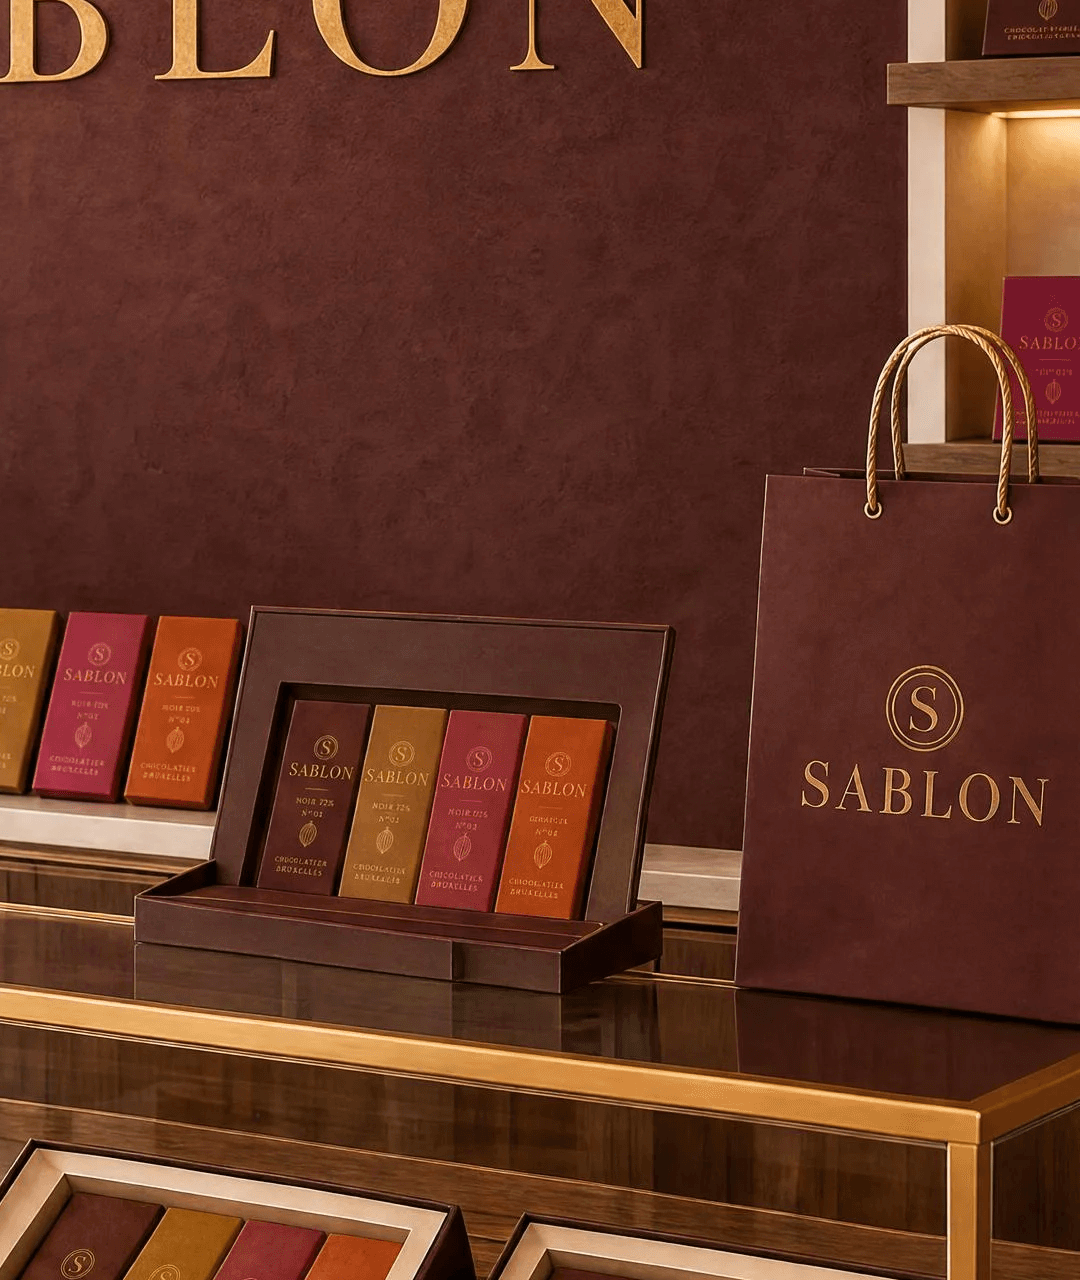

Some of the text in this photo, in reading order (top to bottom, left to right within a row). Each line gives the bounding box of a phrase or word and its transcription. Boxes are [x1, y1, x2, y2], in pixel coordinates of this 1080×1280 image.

[1020, 335, 1080, 350] SABLO
[4, 645, 12, 655] S
[95, 649, 104, 660] S
[185, 653, 194, 665] S
[64, 668, 127, 684] SABLON
[154, 673, 219, 689] SABLON
[910, 686, 938, 732] S
[321, 740, 331, 755] S
[395, 747, 407, 761] S
[473, 752, 484, 766] S
[552, 757, 564, 771] S
[289, 762, 353, 780] SABLON
[364, 768, 430, 786] SABLON
[441, 773, 508, 791] SABLON
[521, 780, 587, 798] SABLON
[296, 797, 316, 805] NOIR
[802, 761, 1049, 826] SABLON
[69, 1255, 87, 1272] S
